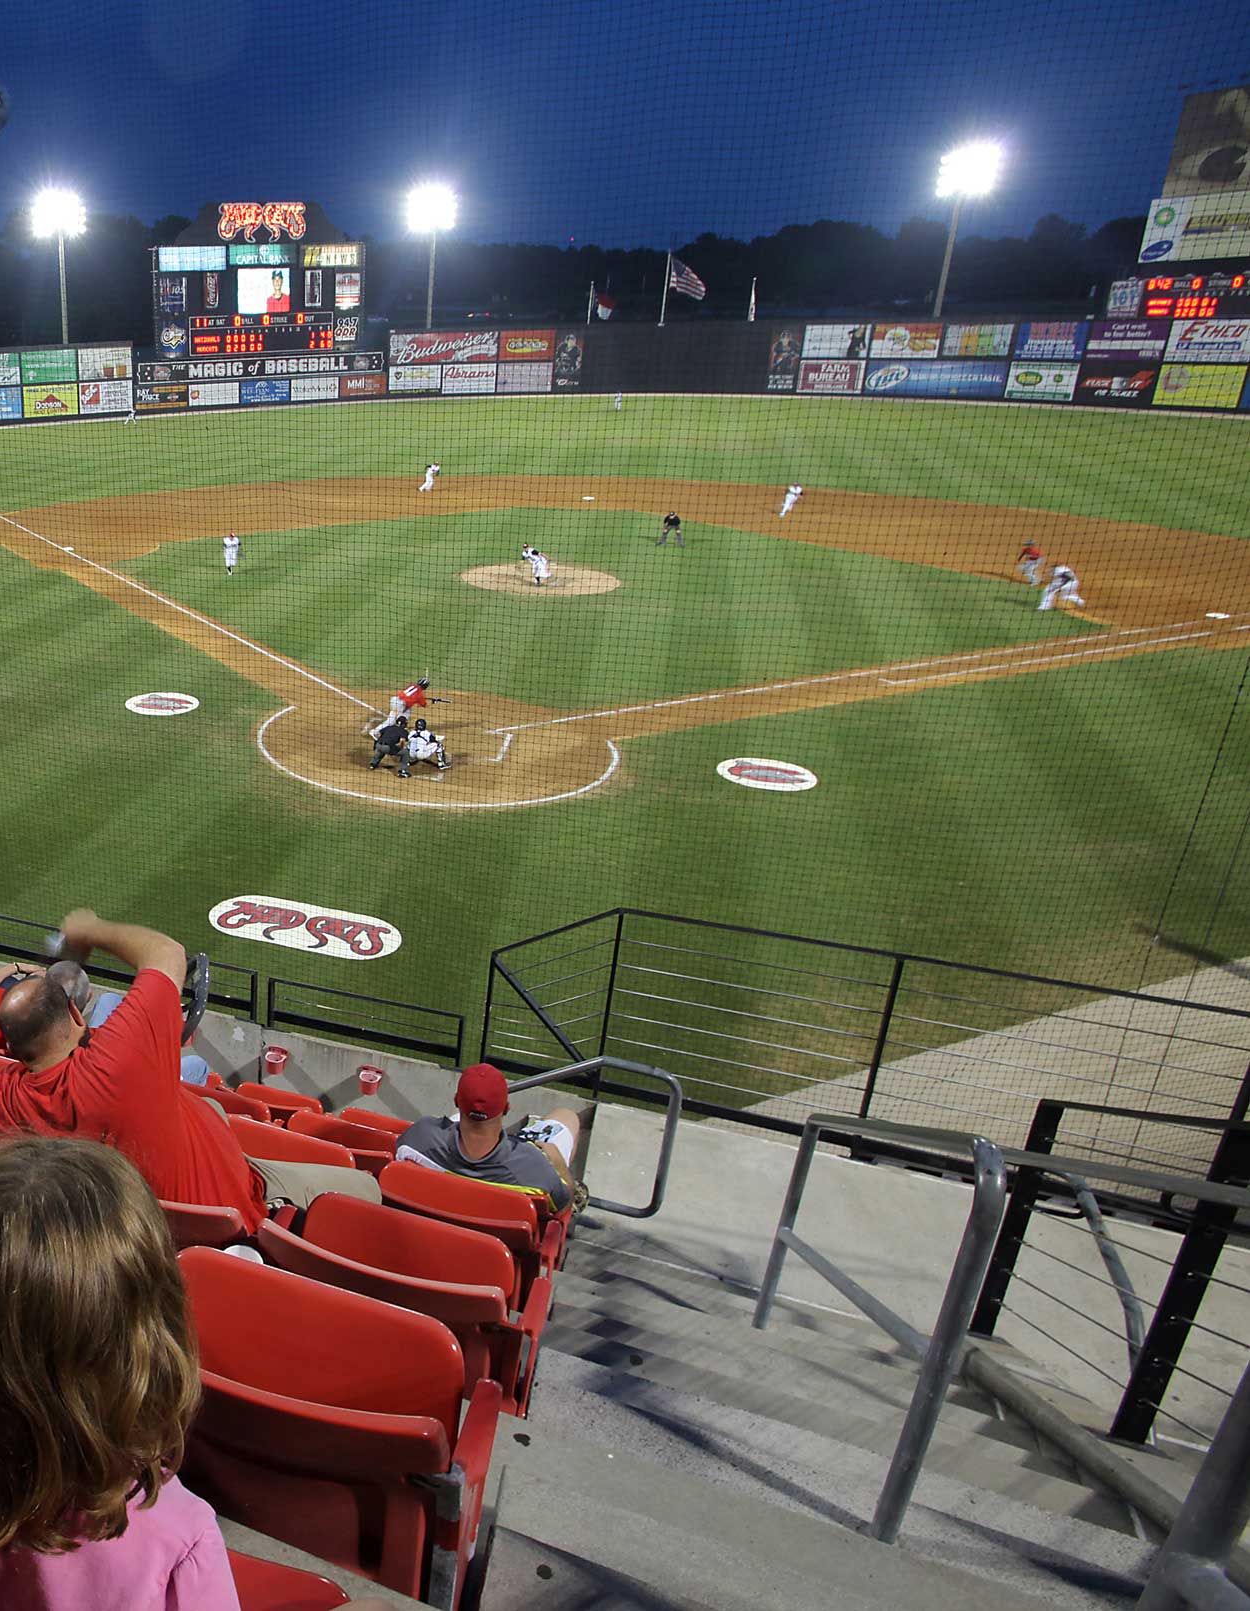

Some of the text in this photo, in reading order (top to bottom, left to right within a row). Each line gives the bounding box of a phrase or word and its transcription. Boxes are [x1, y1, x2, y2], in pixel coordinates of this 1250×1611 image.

[236, 255, 269, 264] CAPITAL
[270, 255, 290, 265] BANK
[326, 254, 356, 264] NEWS
[1192, 277, 1202, 290] 0
[1232, 275, 1244, 288] 0
[195, 317, 208, 327] 11
[234, 315, 241, 326] 0
[263, 314, 270, 325] 0
[297, 313, 304, 324] 0
[334, 328, 356, 337] QDR
[1180, 320, 1248, 341] ETHCO
[397, 332, 491, 364] Budweiser
[188, 362, 243, 378] MAGIC
[248, 361, 260, 375] of
[265, 357, 348, 374] BASEBALL
[821, 363, 850, 372] FARM
[445, 367, 495, 379] Abrams
[809, 373, 850, 381] BUREAU
[137, 388, 149, 398] RAY
[403, 685, 418, 697] 11
